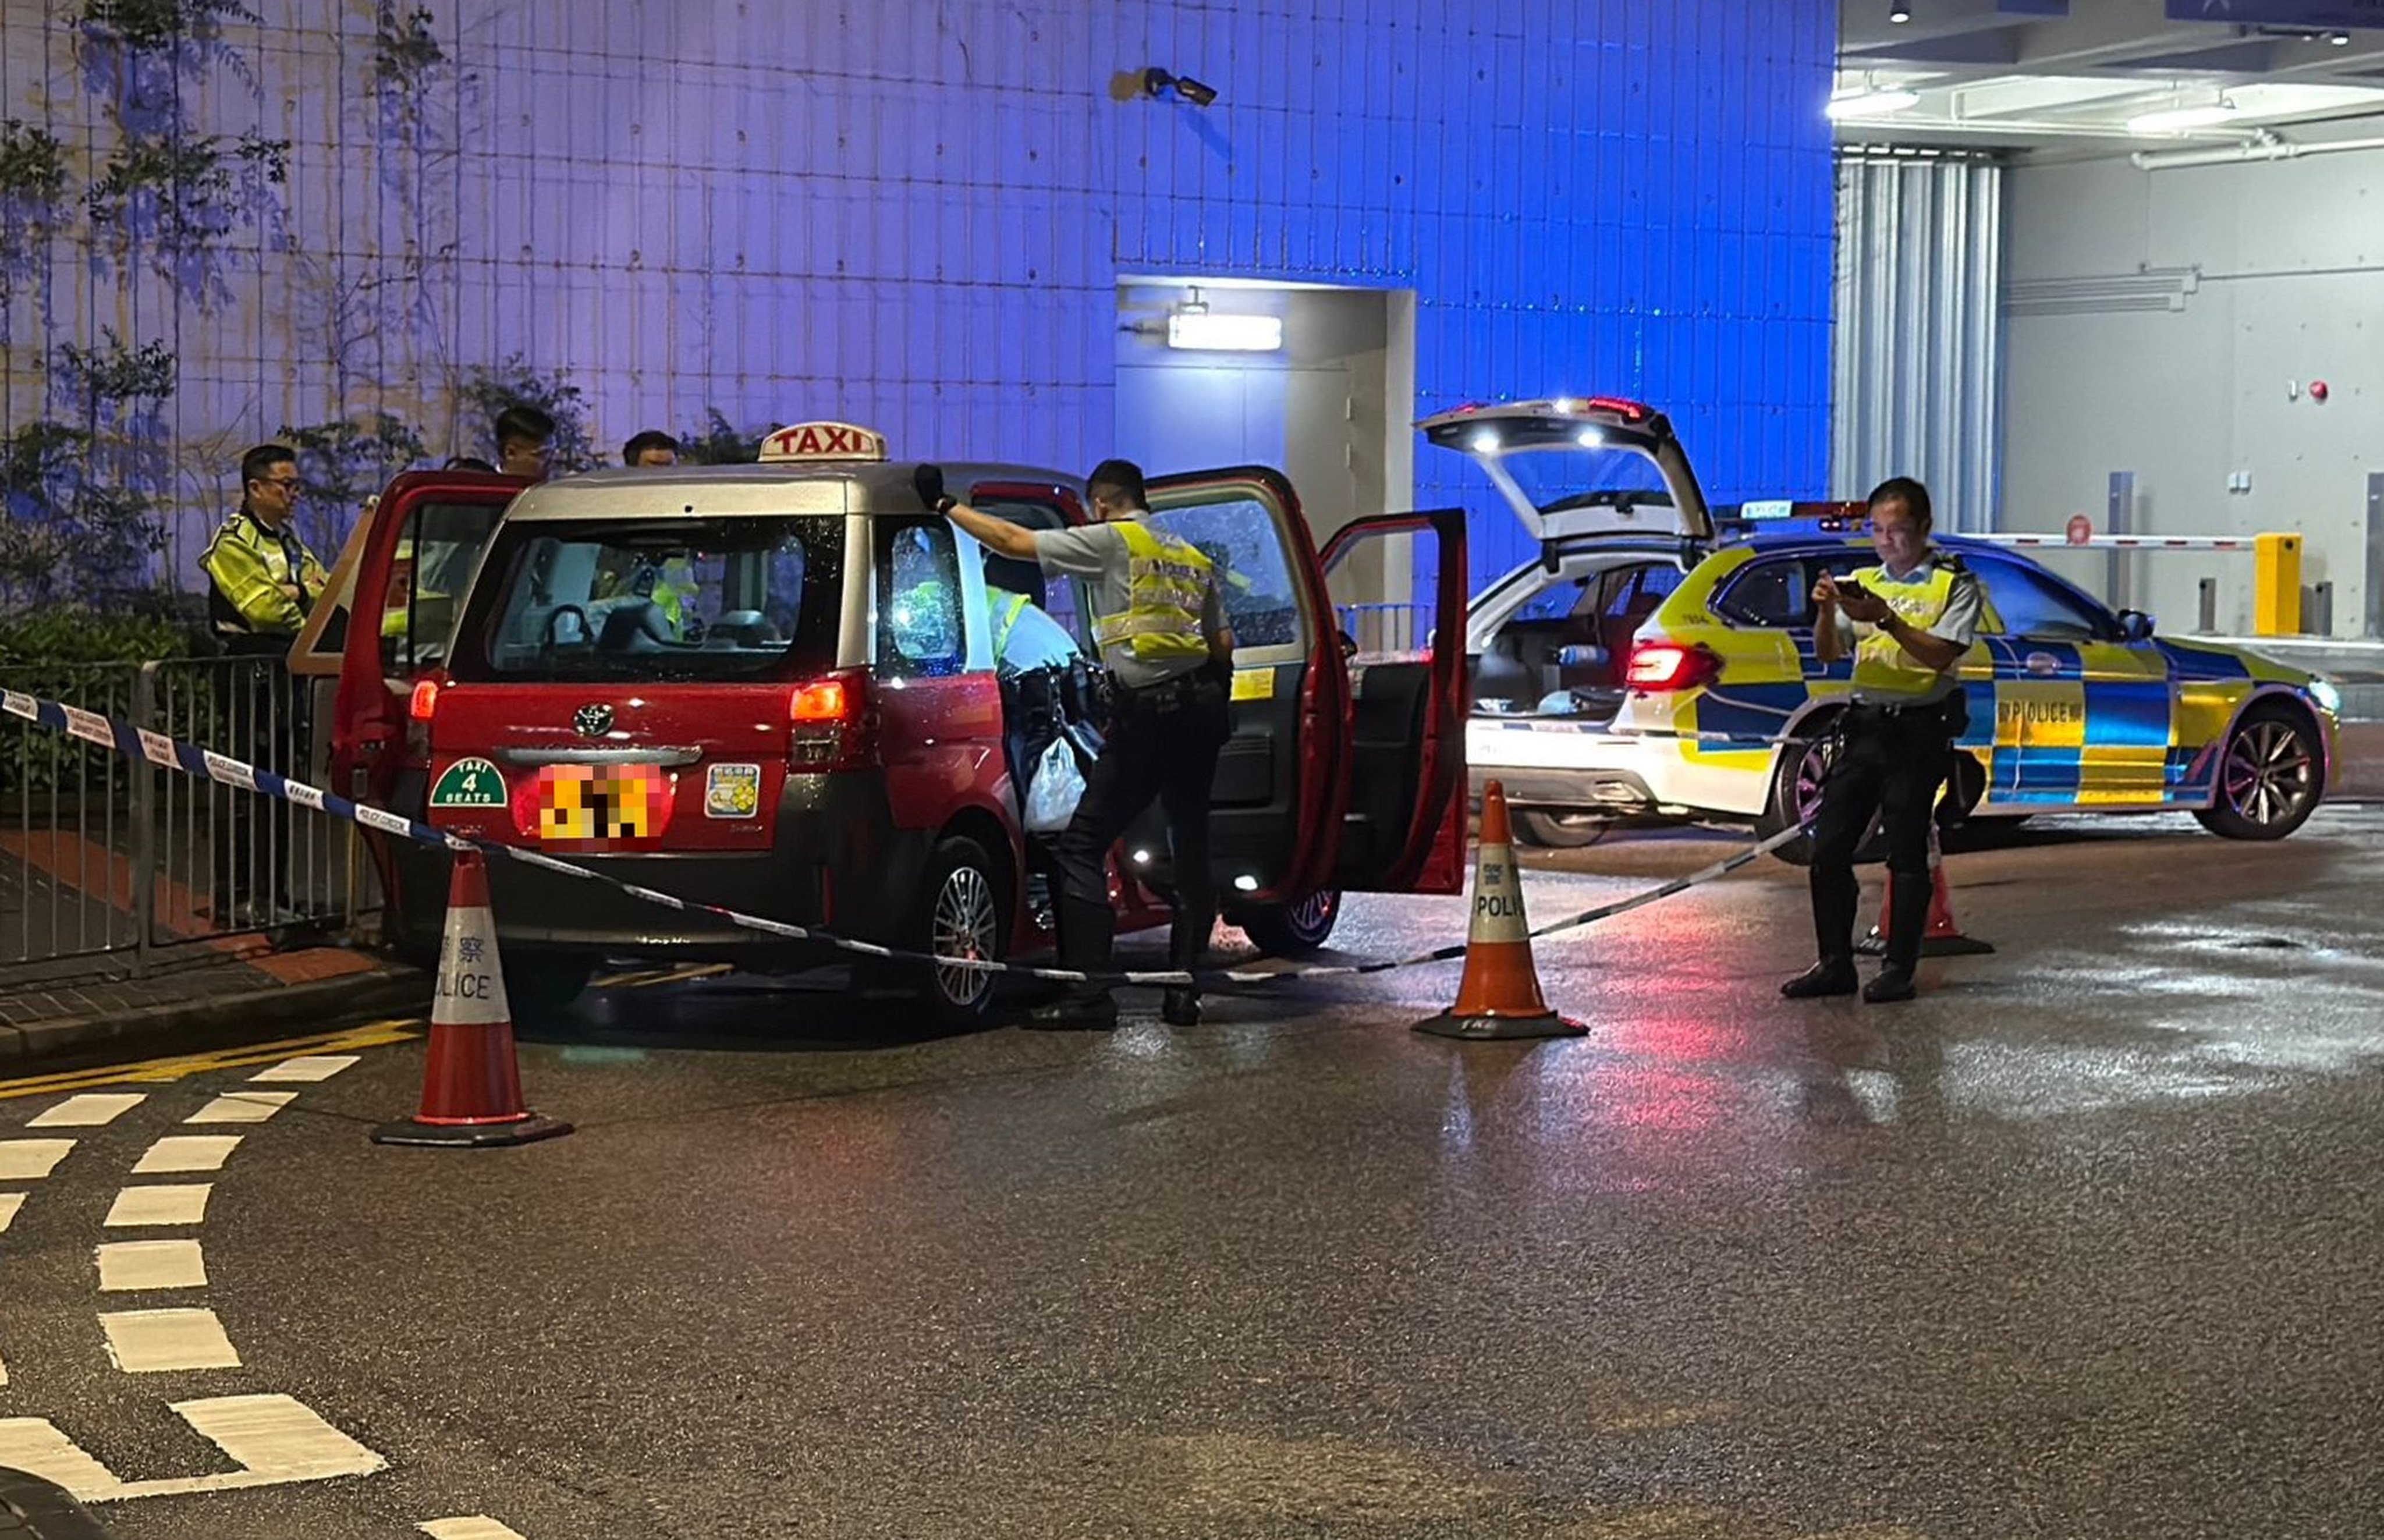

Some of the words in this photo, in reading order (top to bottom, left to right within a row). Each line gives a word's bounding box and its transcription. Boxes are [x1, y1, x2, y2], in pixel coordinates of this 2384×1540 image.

[774, 426, 862, 453] TAXI
[2012, 702, 2067, 722] POLICE
[459, 761, 488, 773] TAXI
[462, 772, 477, 792] 4
[446, 793, 491, 803] SEATS
